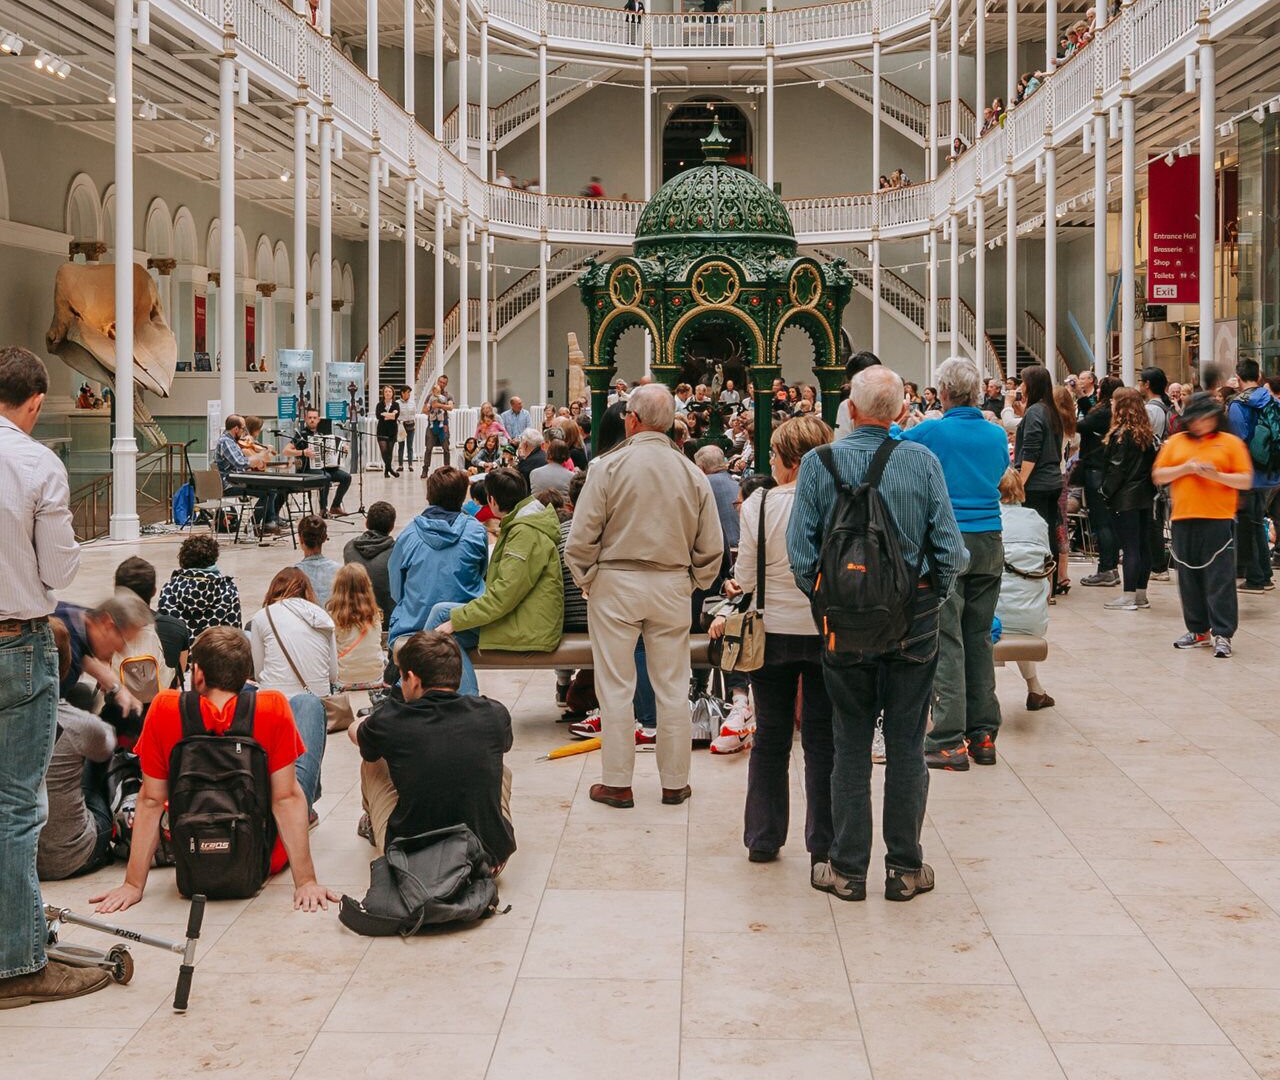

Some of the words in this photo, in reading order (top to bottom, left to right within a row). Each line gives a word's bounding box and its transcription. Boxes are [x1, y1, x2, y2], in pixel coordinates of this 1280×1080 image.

[1153, 232, 1182, 240] Entrance
[1183, 232, 1197, 240] Hall
[1153, 259, 1171, 267] Shop
[1155, 287, 1175, 296] Exit
